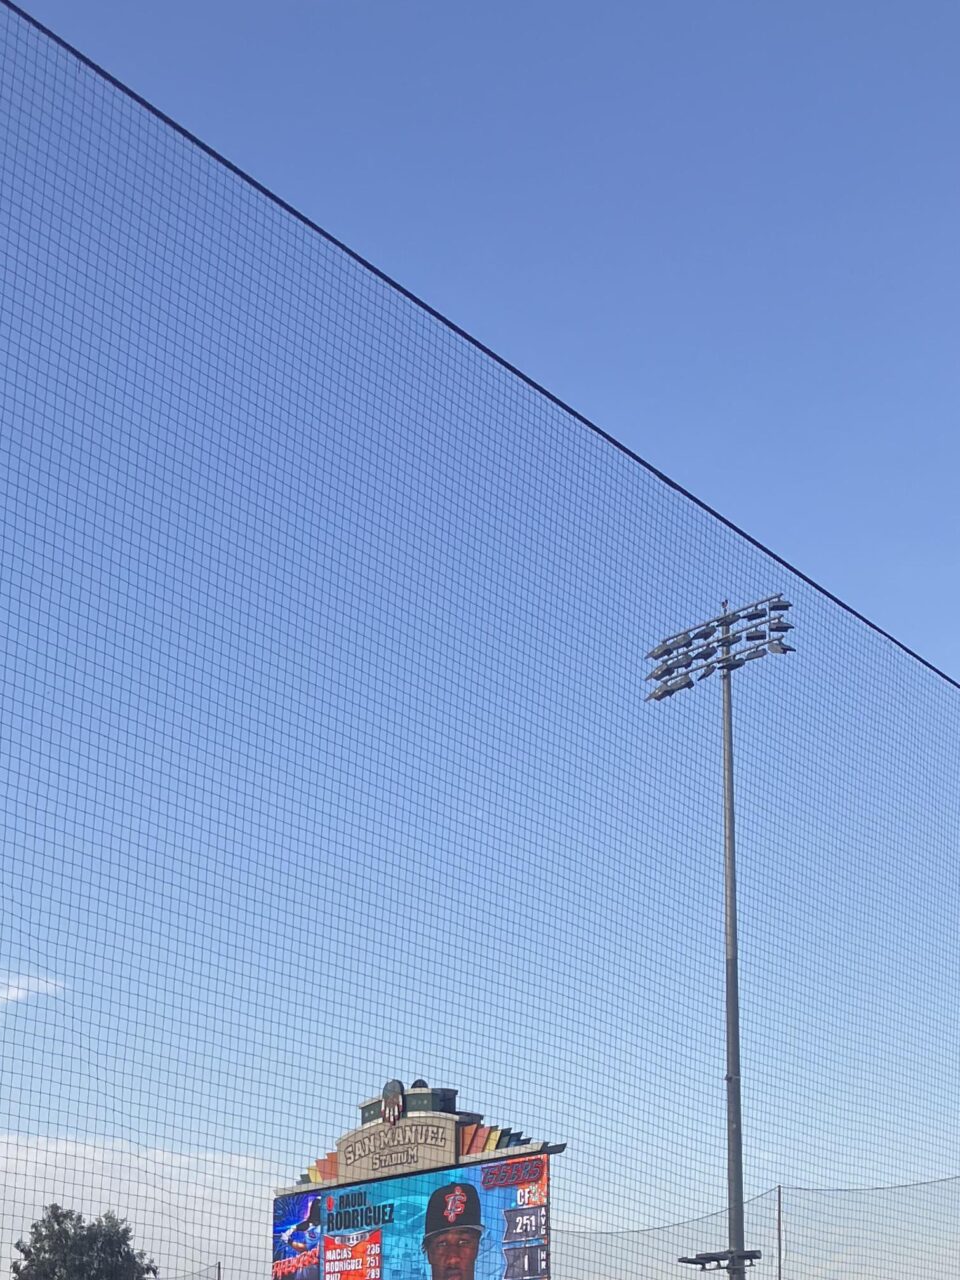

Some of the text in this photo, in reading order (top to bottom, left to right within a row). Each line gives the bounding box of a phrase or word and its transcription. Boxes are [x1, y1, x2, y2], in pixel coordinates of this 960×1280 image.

[344, 1125, 446, 1166] SAN MANUEL
[372, 1144, 418, 1171] STADIUM
[327, 1203, 395, 1232] RODRIGUEZ
[513, 1215, 536, 1233] .251
[325, 1256, 379, 1272] RODRIGUEZ 251
[326, 1248, 352, 1260] MACIAS
